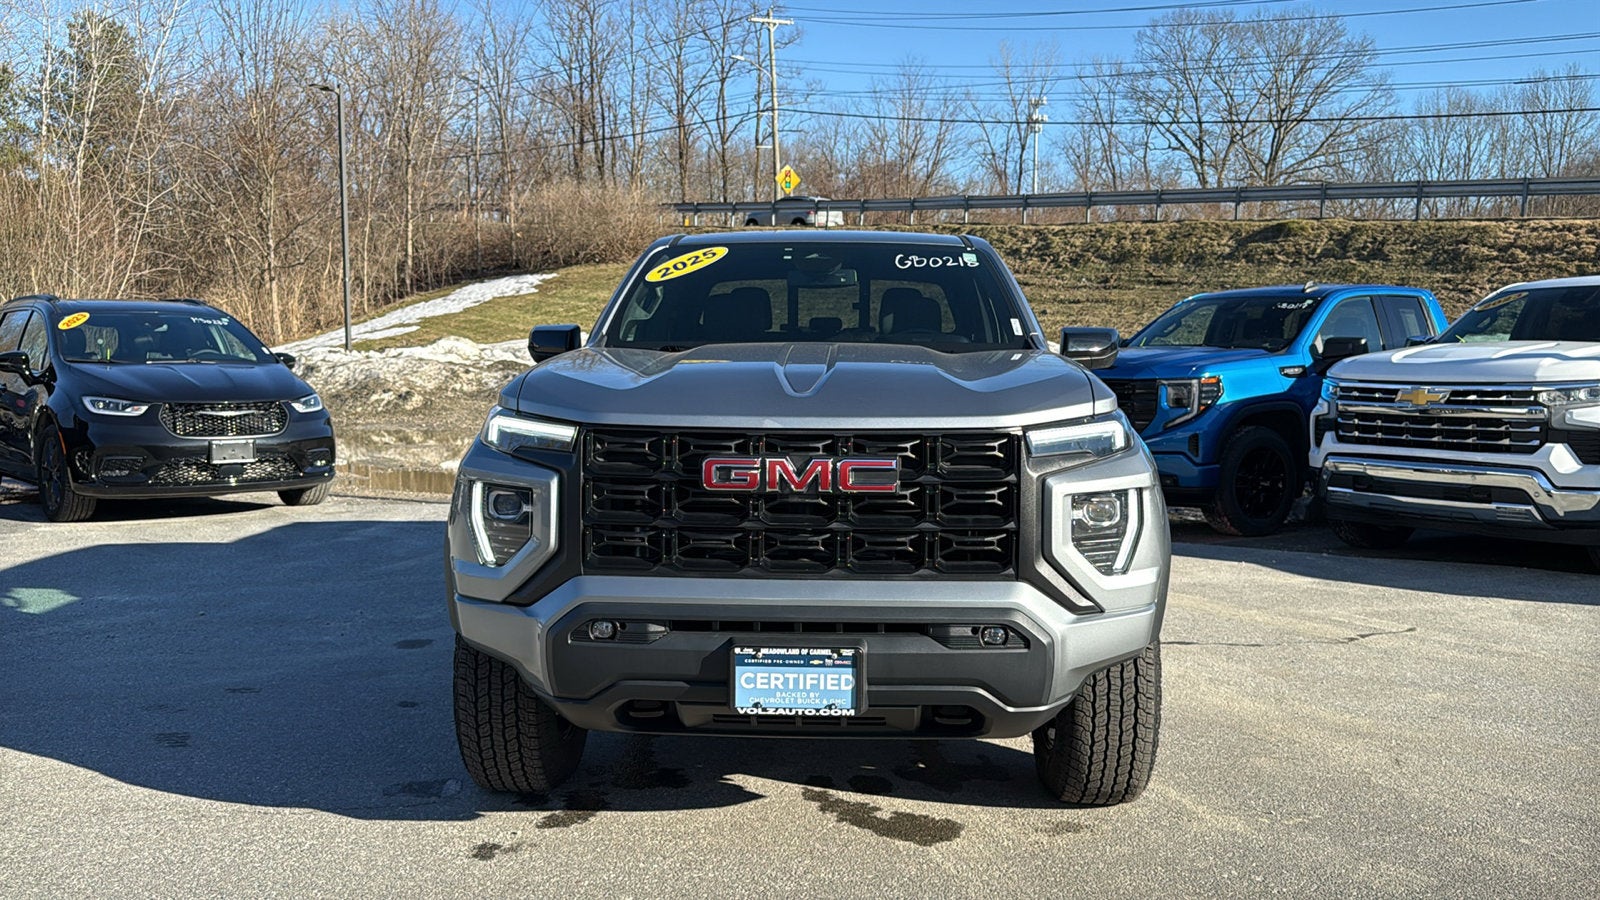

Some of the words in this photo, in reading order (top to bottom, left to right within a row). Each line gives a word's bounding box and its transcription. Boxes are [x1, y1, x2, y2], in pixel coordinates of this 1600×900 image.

[657, 249, 717, 279] 2025
[702, 456, 898, 493] GMC
[760, 648, 800, 656] MEADOWLAND
[801, 648, 809, 656] OF
[809, 648, 833, 656] CARMEL
[740, 672, 855, 690] CERTIFIED
[737, 707, 855, 716] VOLZAUTO.COM
